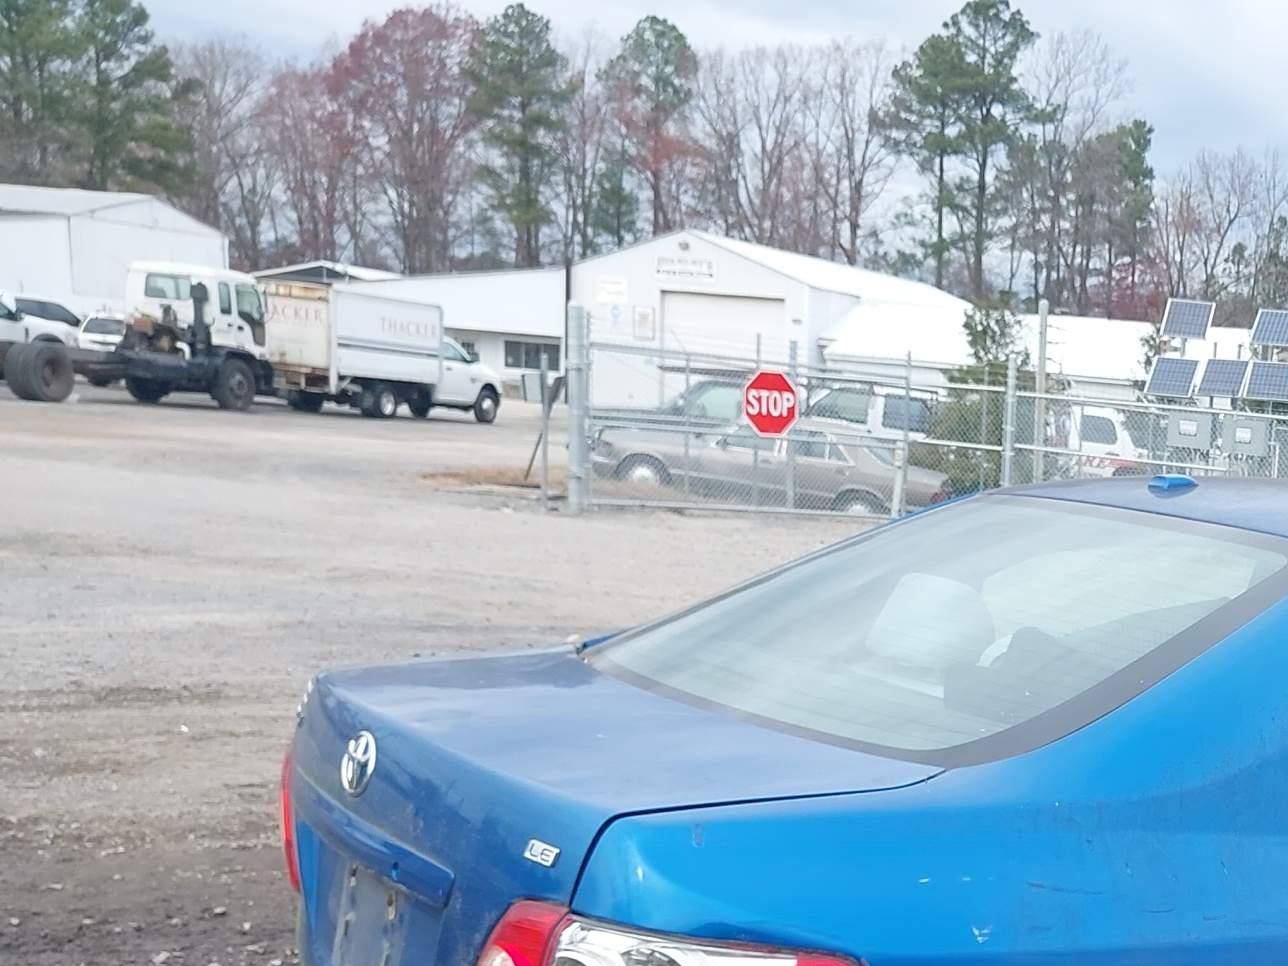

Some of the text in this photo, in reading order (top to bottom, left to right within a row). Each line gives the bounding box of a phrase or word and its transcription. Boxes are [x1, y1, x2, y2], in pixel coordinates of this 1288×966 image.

[380, 316, 437, 337] THACKER
[747, 388, 795, 418] STOP
[529, 842, 555, 863] LE
